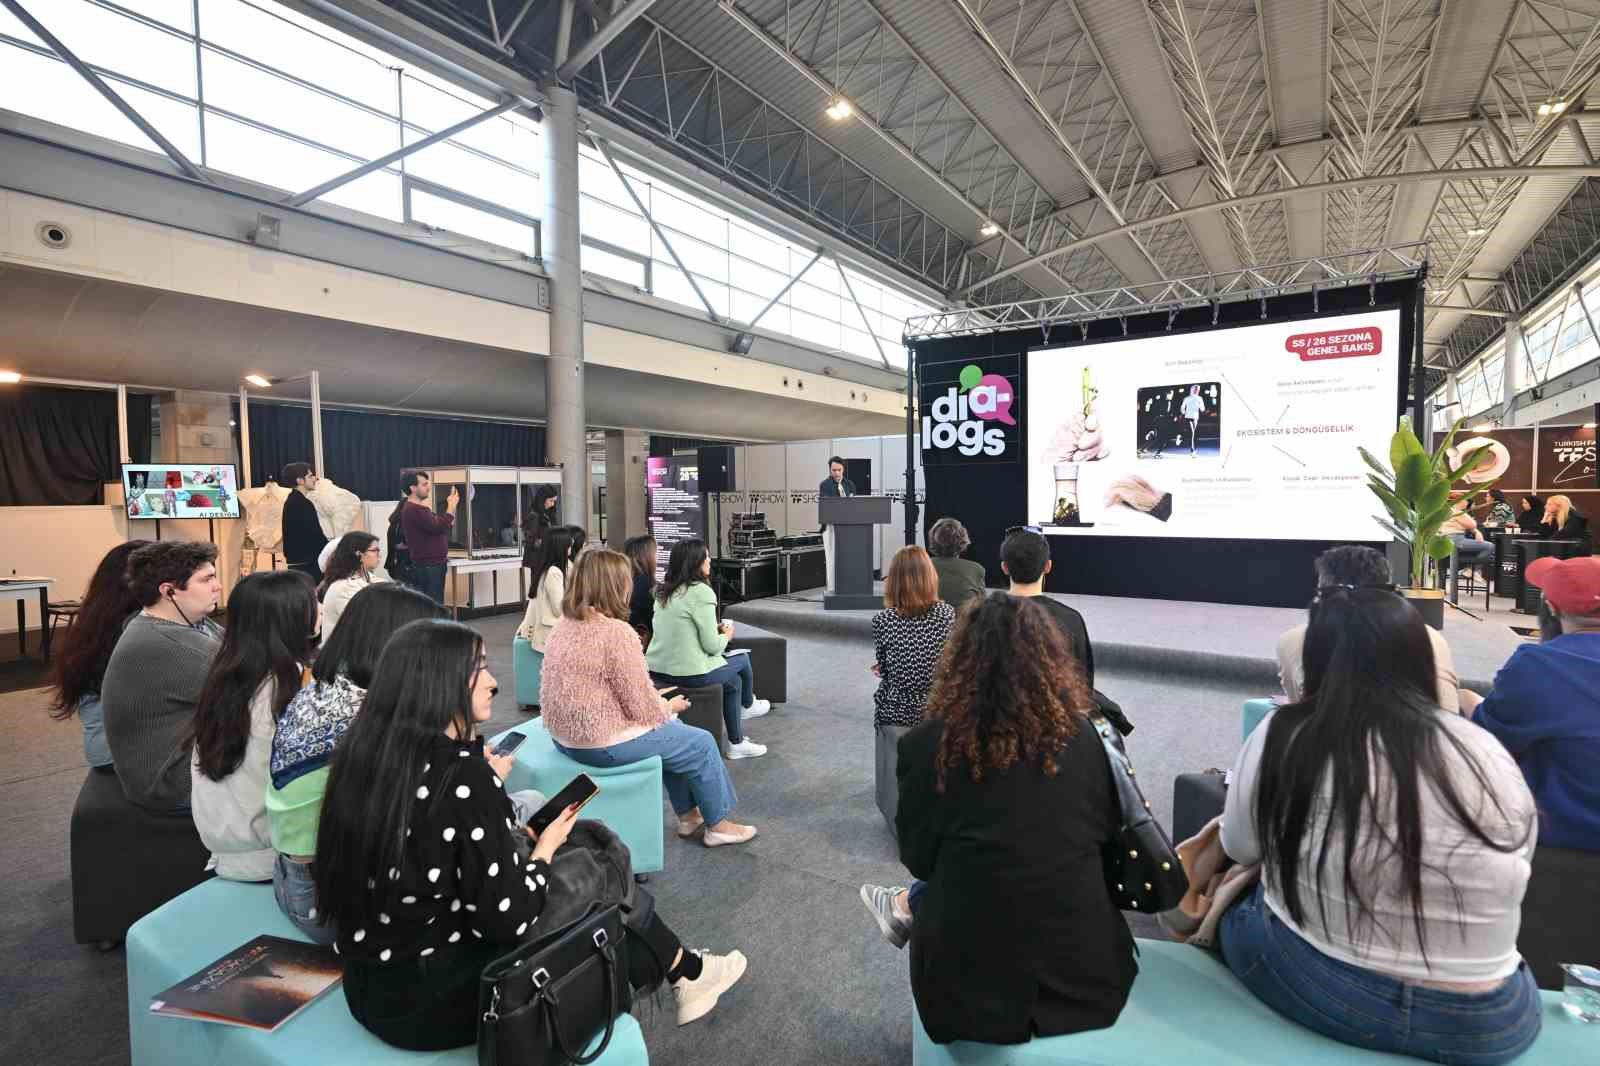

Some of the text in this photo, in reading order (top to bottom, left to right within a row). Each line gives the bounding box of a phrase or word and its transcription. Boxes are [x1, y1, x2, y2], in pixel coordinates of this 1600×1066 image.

[1292, 339, 1306, 348] SS
[1328, 332, 1372, 344] SEZONA
[1307, 342, 1375, 356] GENEL BAKIŞ
[922, 416, 1006, 456] logs
